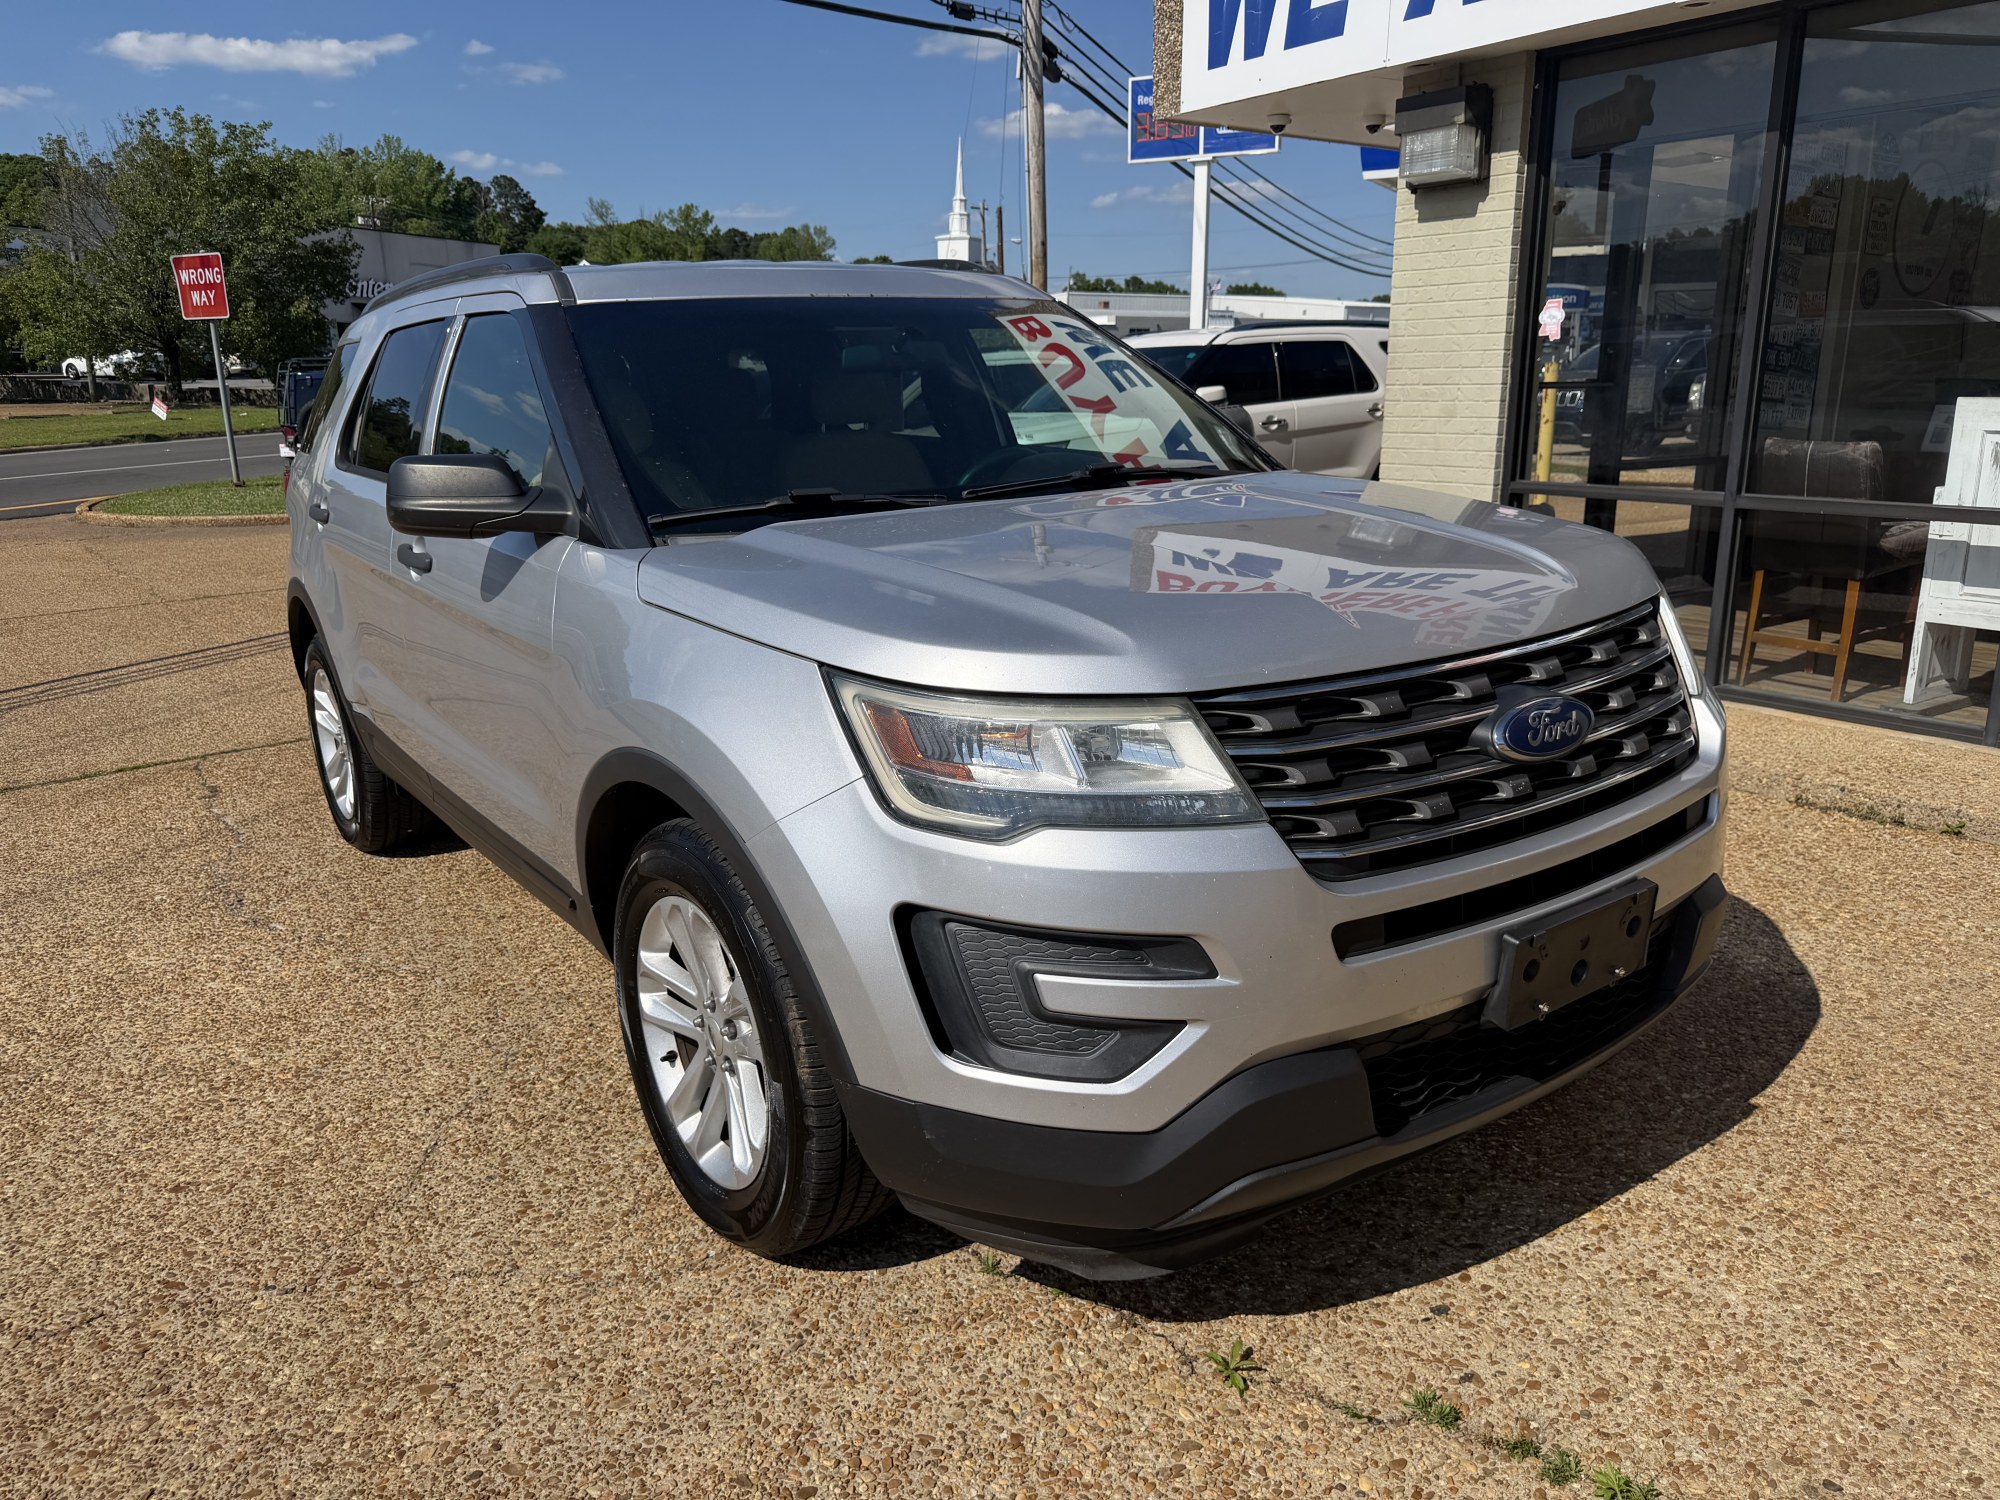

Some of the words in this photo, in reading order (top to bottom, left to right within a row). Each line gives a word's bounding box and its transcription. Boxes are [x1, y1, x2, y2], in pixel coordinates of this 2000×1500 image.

[179, 267, 221, 285] WRONG
[191, 289, 215, 306] WAY
[1527, 706, 1580, 747] Ford
